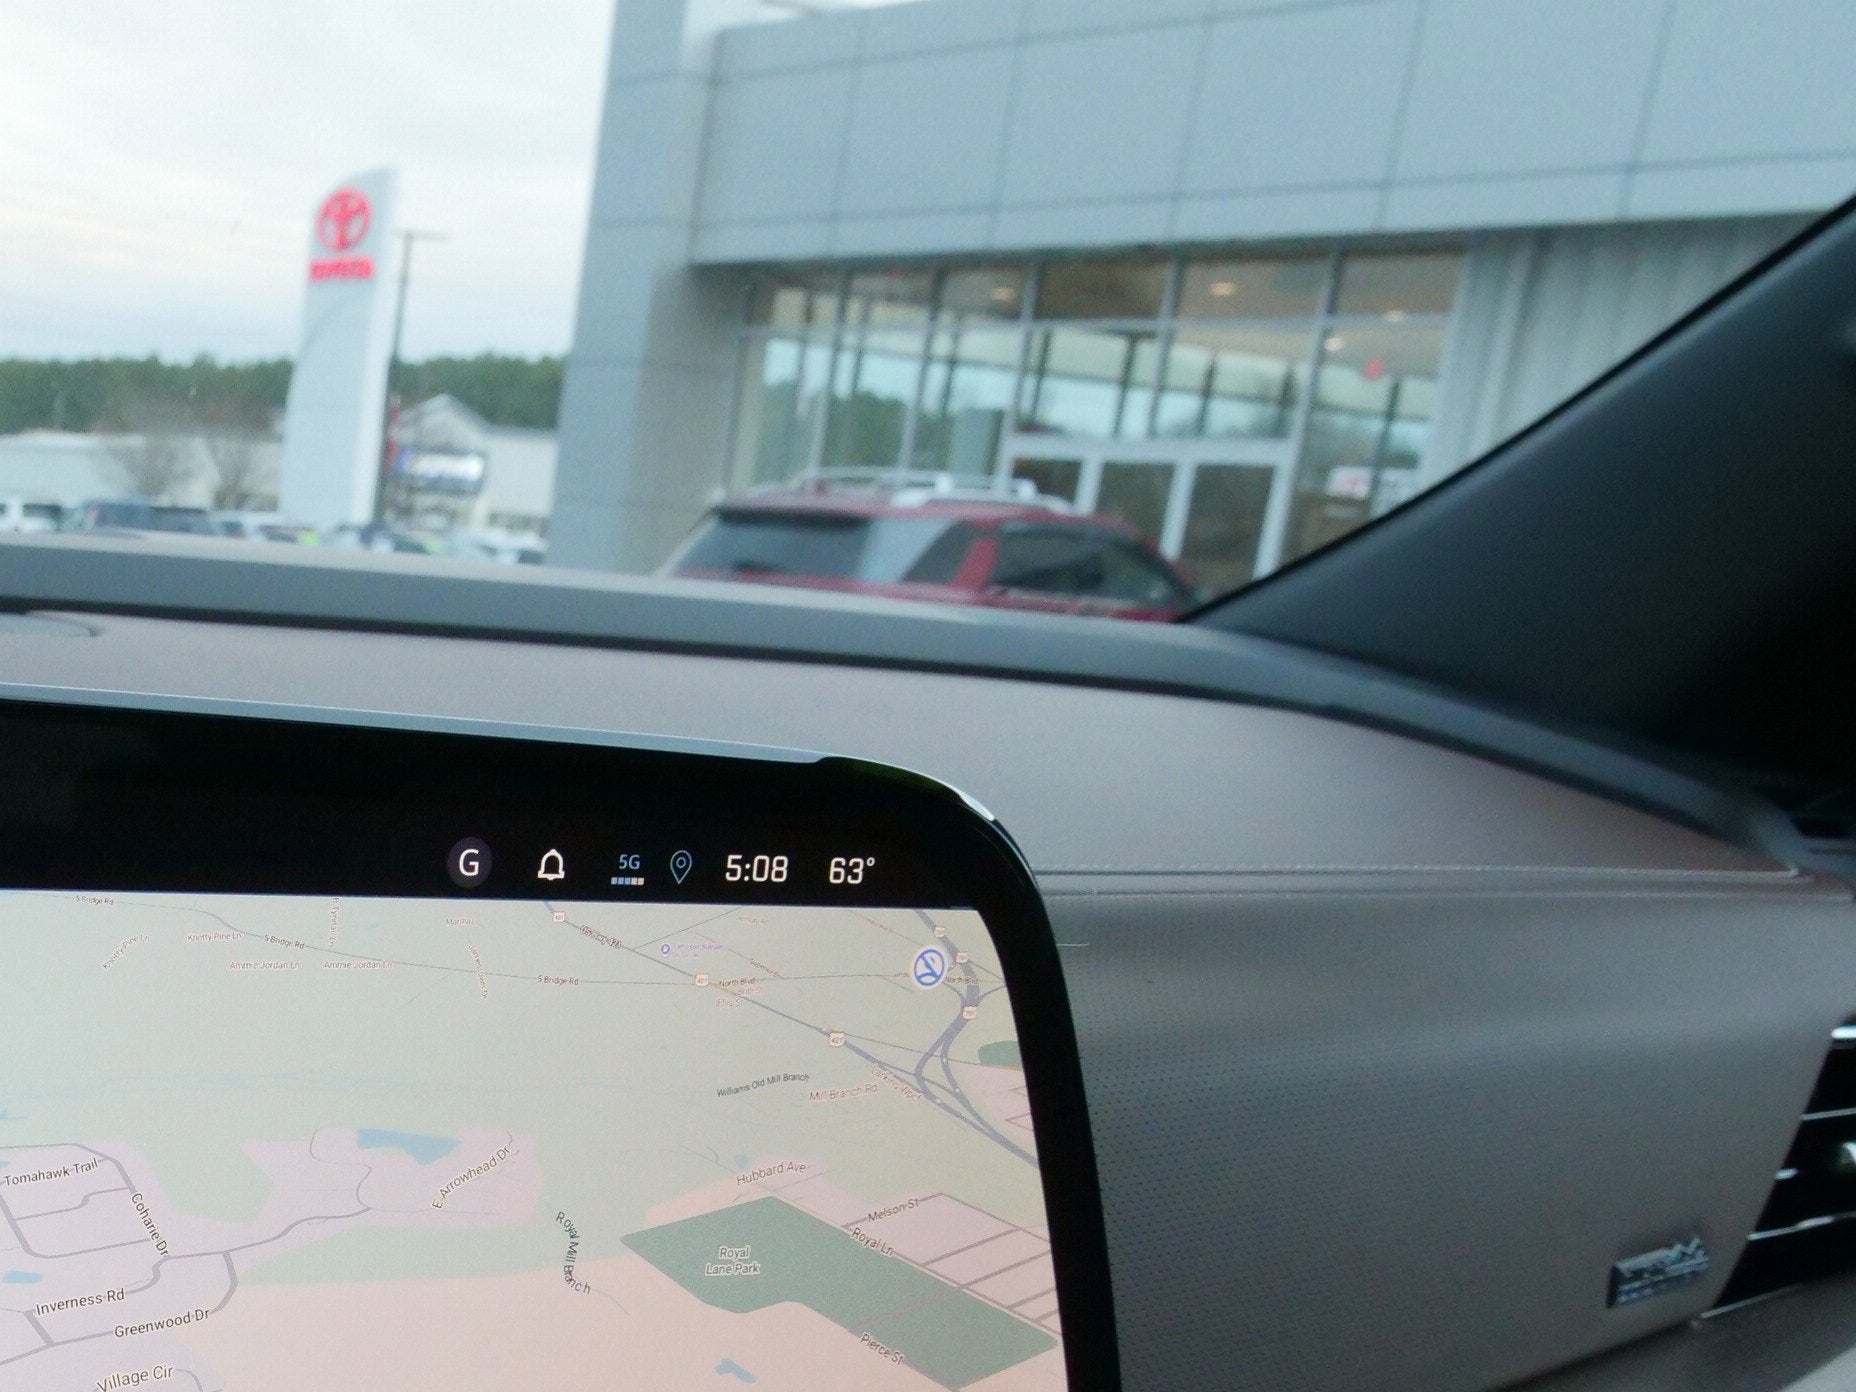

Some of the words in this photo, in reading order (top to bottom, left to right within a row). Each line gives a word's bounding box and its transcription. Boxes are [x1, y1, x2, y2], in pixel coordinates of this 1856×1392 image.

[459, 849, 480, 877] G
[618, 854, 641, 871] 5G
[725, 854, 788, 883] 5:08
[3, 1166, 71, 1186] Tomahawk
[72, 1157, 99, 1175] Trail
[439, 1157, 498, 1200] Arrowhead
[496, 1144, 512, 1161] Dr
[736, 1162, 784, 1186] Hubbard
[785, 1160, 807, 1174] Ave
[867, 1202, 905, 1223] Melson
[907, 1197, 920, 1209] St
[131, 1193, 161, 1241] Coharie
[155, 1239, 170, 1257] Dr
[556, 1211, 579, 1240] Royal
[565, 1240, 579, 1264] Mill
[719, 1245, 751, 1261] Royal
[851, 1226, 880, 1250] Royal
[880, 1241, 894, 1257] Ln
[706, 1262, 730, 1276] Lane
[731, 1262, 761, 1276] Park
[35, 1294, 104, 1316] Inverness
[106, 1287, 126, 1303] Rd
[114, 1311, 192, 1338] Greenwood
[194, 1308, 211, 1322] Dr
[860, 1332, 891, 1359] Pierce
[891, 1351, 905, 1366] St
[96, 1370, 149, 1392] Village
[152, 1365, 174, 1380] Cir
